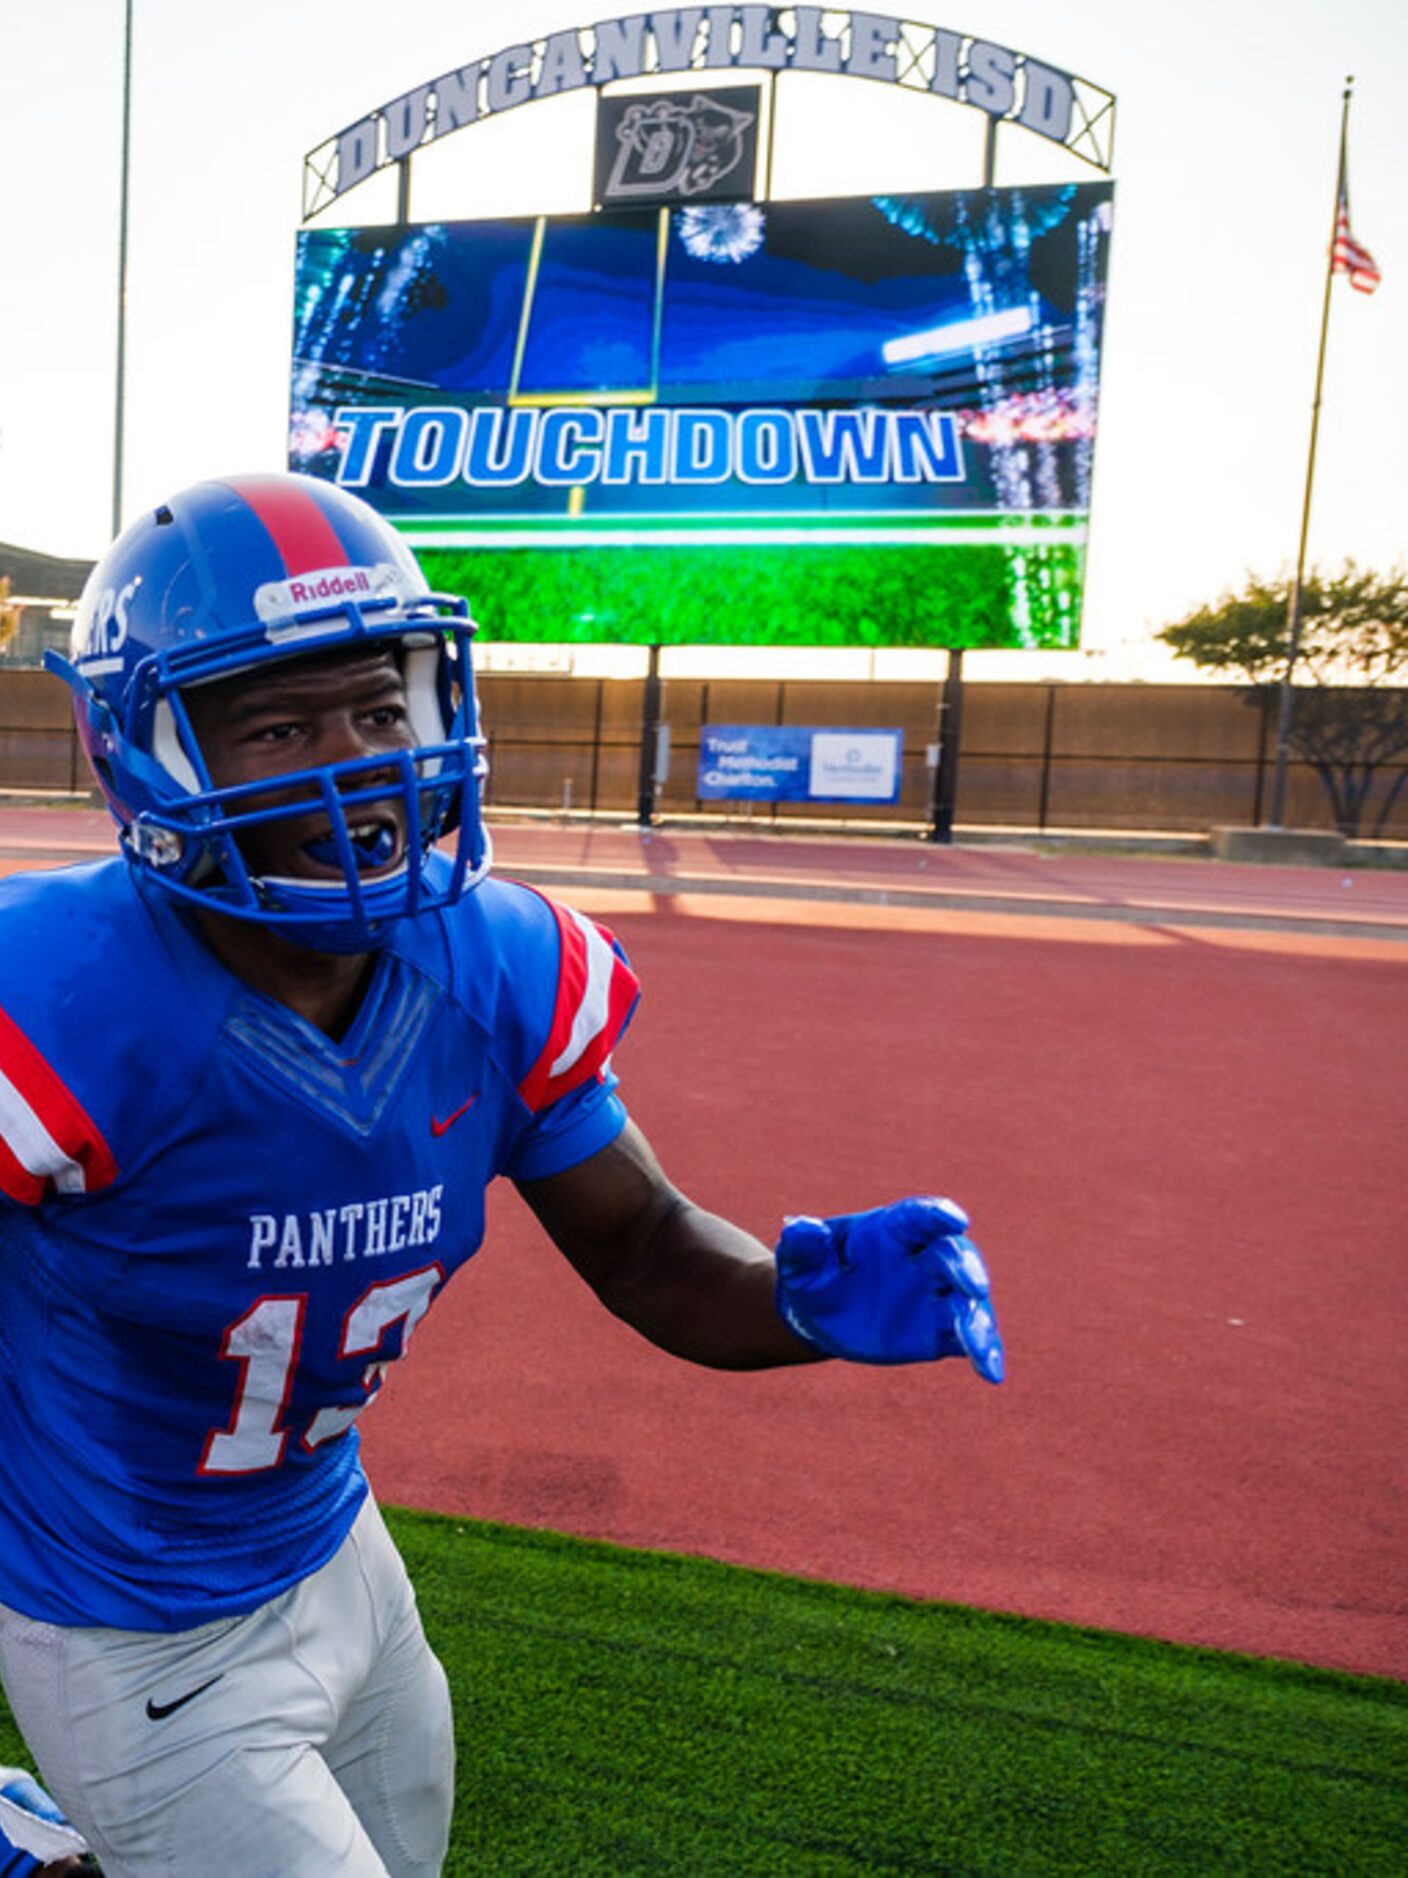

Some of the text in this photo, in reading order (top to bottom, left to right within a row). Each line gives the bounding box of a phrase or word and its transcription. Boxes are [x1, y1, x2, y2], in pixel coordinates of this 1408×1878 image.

[336, 5, 1076, 195] DUNCANVILLE ISD
[336, 406, 966, 487] TOUCHDOWN
[289, 571, 370, 603] Riddell
[247, 1184, 443, 1268] PANTHERS
